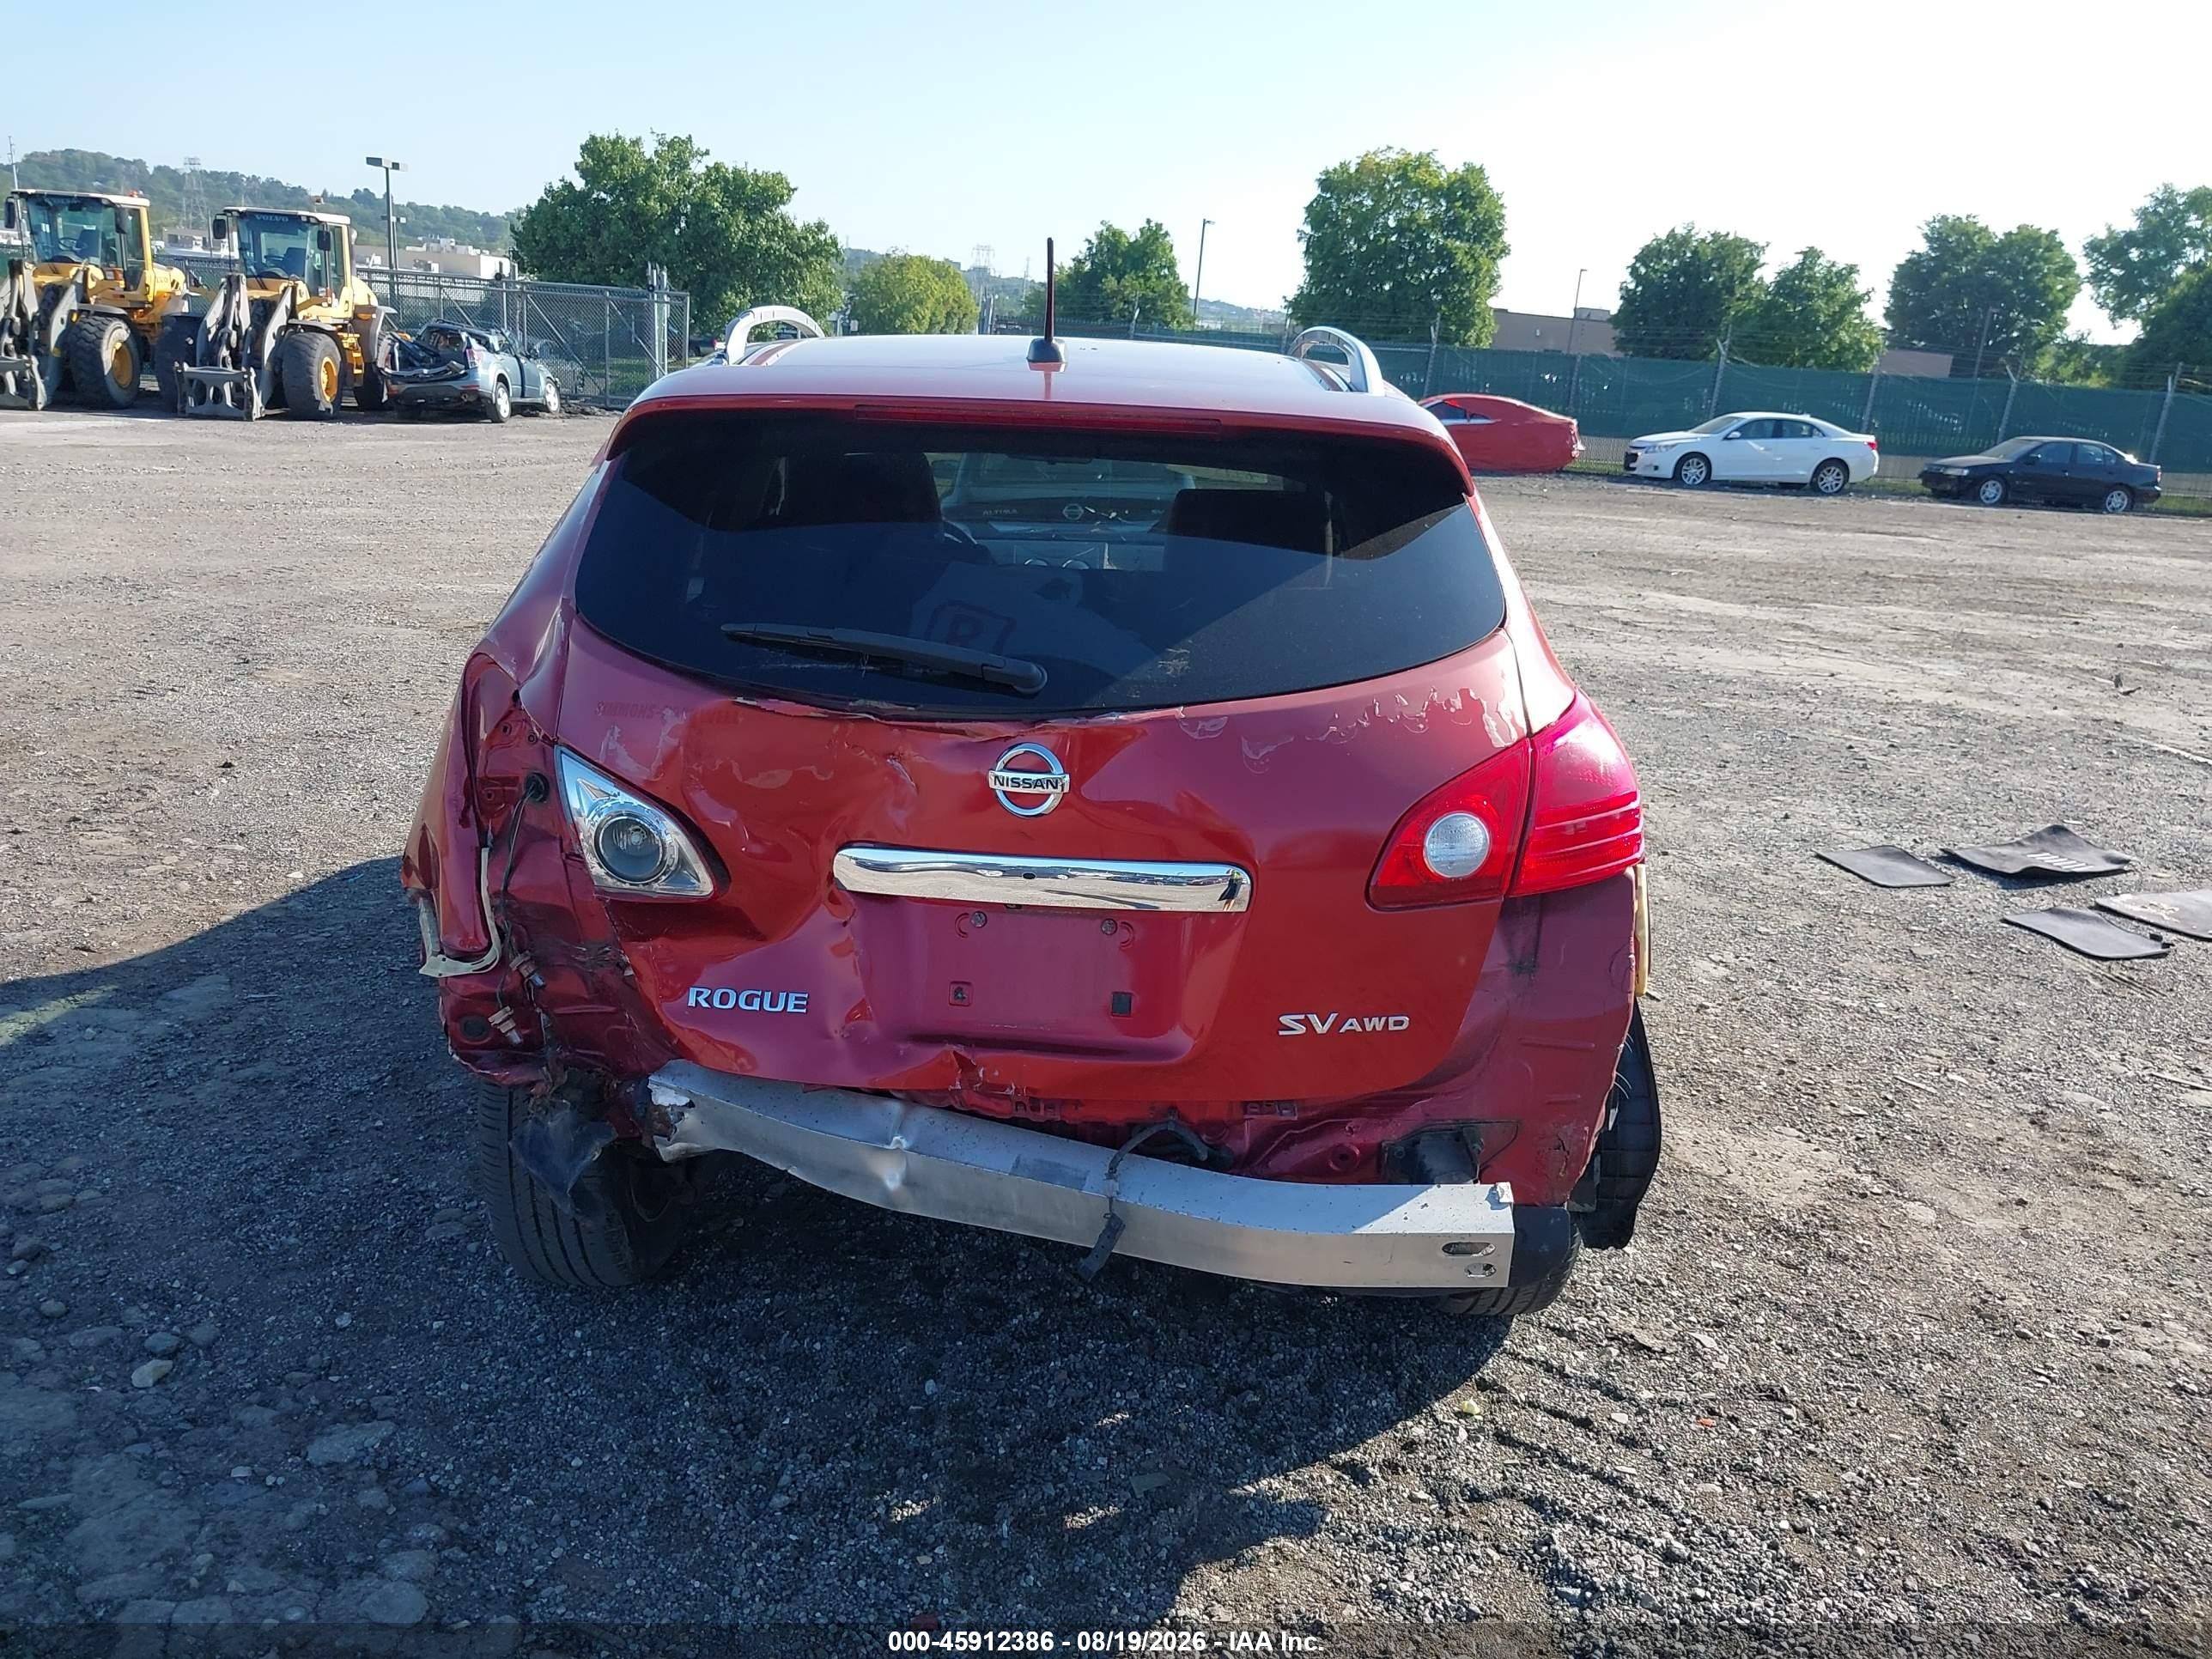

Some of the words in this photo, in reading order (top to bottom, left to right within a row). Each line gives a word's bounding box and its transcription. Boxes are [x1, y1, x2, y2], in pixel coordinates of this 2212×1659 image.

[994, 775, 1059, 790] NISSAN
[687, 986, 809, 1014] ROGUE
[1278, 1012, 1340, 1036] SV
[1339, 1015, 1410, 1033] AWD
